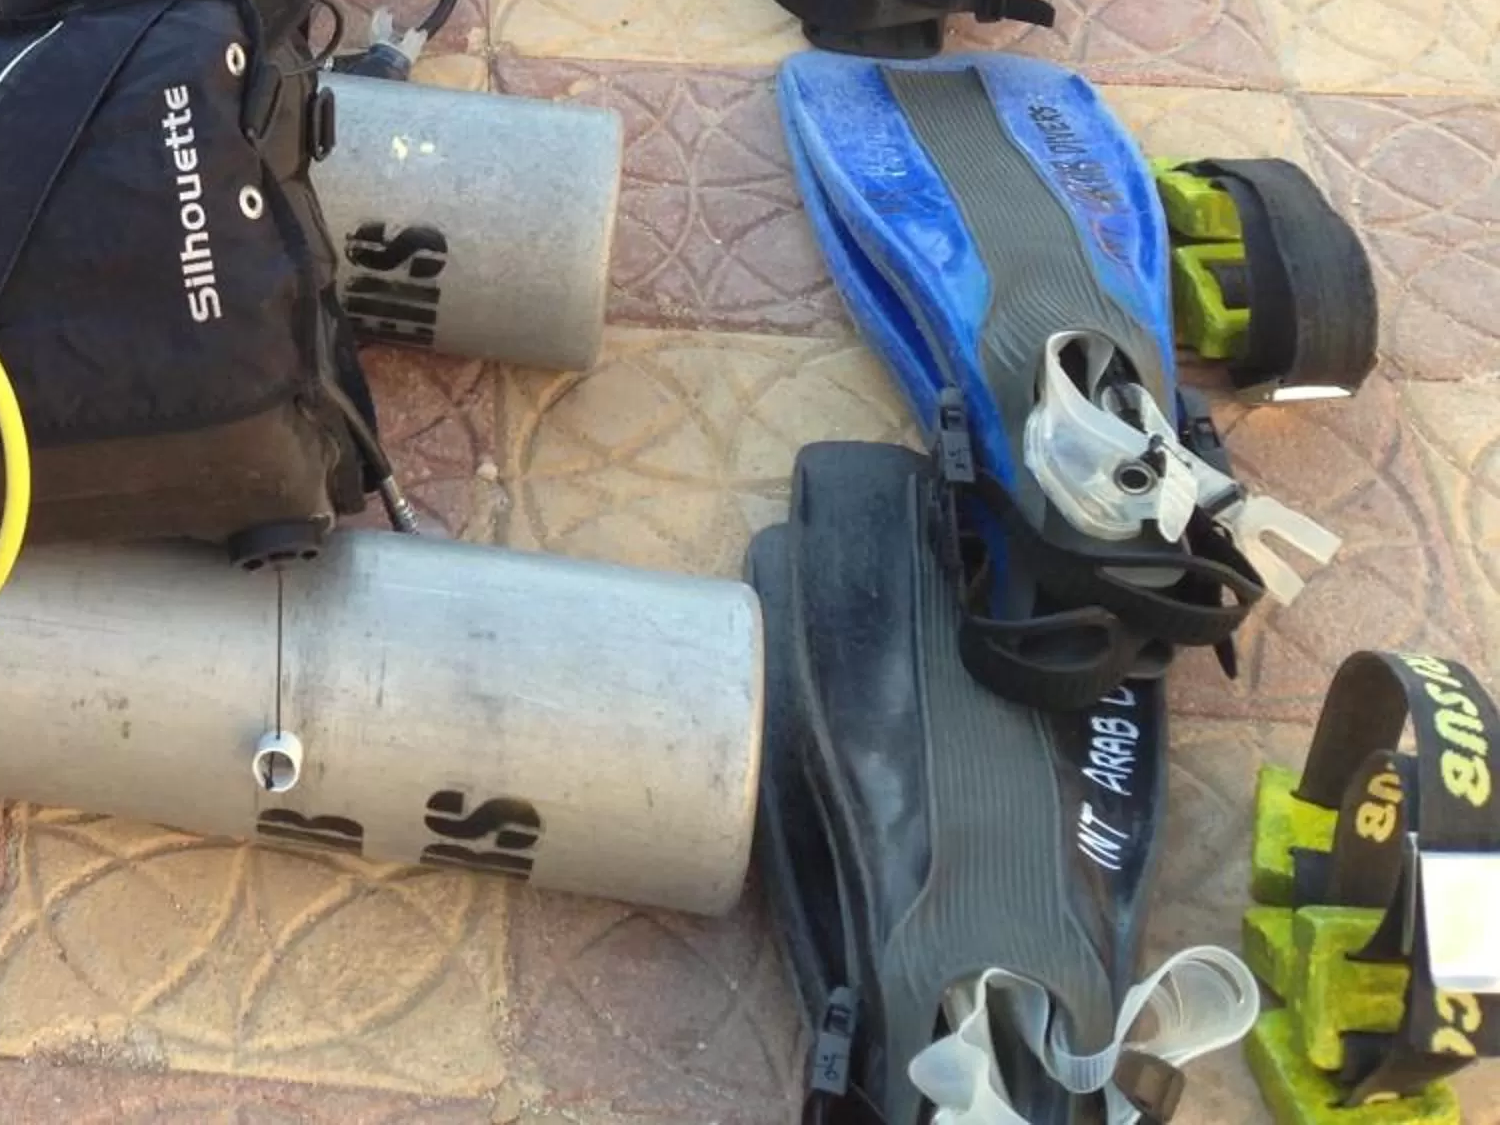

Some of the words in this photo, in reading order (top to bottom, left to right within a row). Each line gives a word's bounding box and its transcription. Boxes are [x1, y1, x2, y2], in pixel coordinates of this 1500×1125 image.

[161, 84, 223, 323] Silhouette
[1081, 715, 1141, 797] ARAB
[1077, 800, 1130, 872] INT
[1355, 763, 1405, 844] UB
